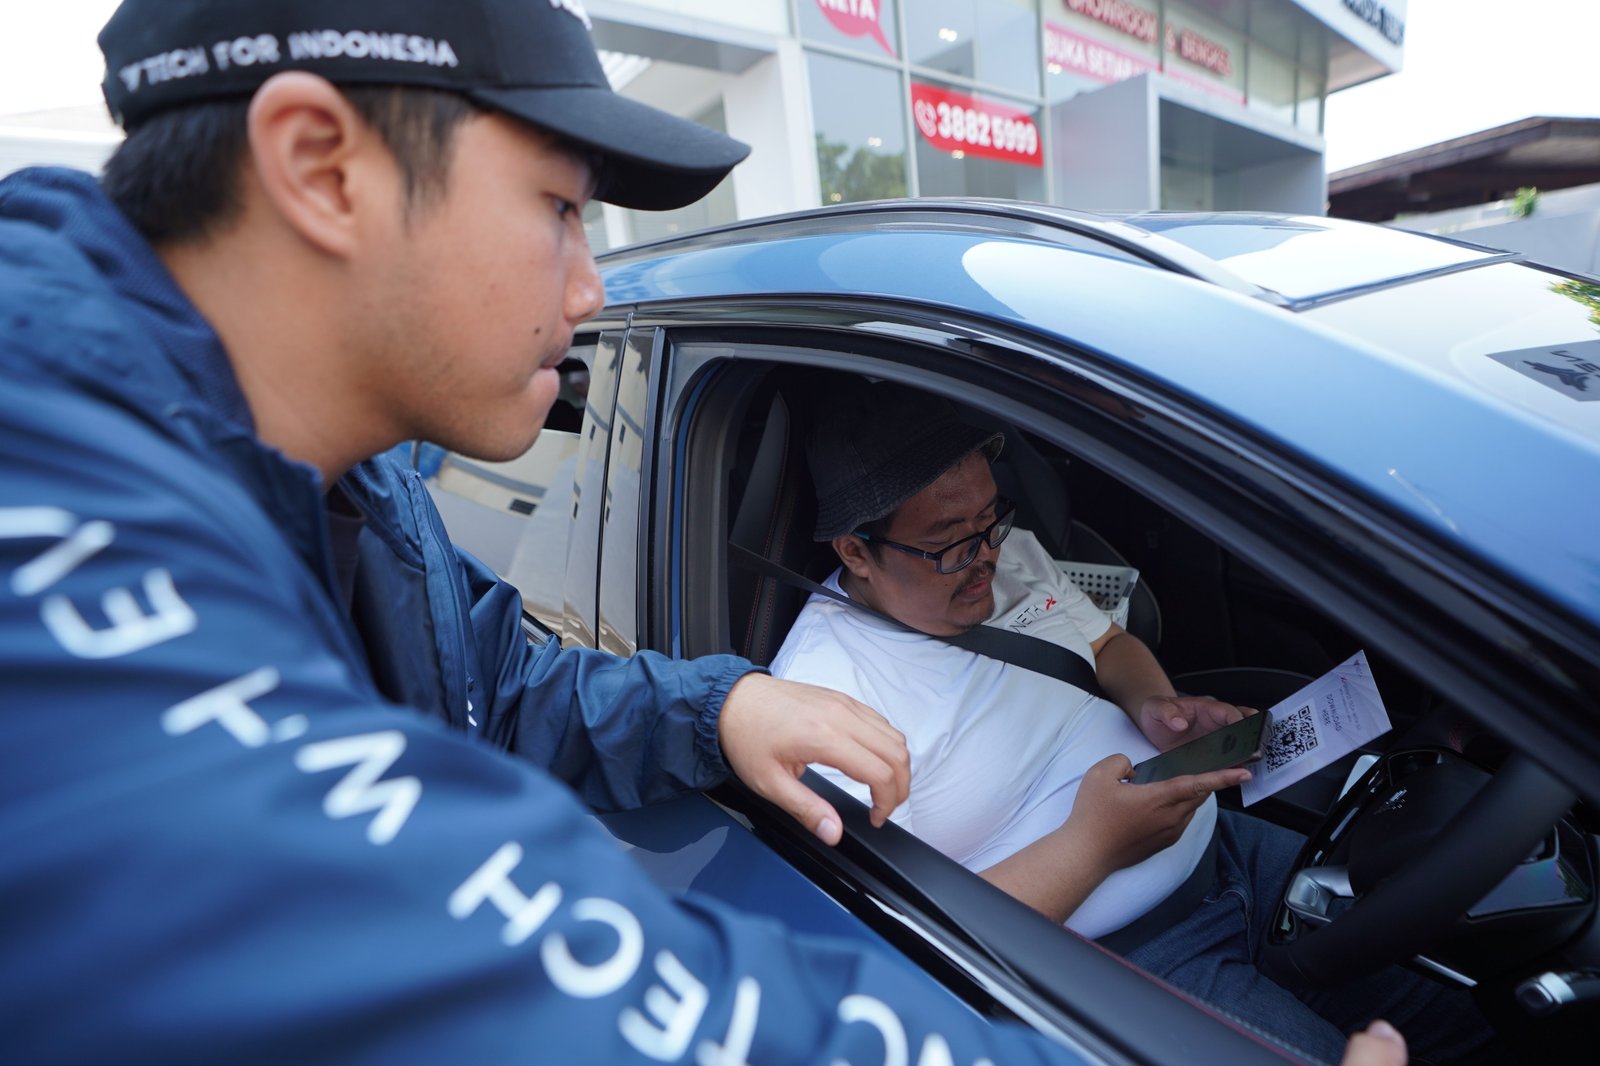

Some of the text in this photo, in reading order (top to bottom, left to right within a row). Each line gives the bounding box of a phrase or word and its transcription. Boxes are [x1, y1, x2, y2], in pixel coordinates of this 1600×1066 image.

[818, 0, 876, 21] ETA
[1064, 0, 1158, 45] OWROOM
[212, 34, 281, 71] FOR
[287, 28, 459, 68] INDONESIA
[1009, 605, 1044, 635] NETA
